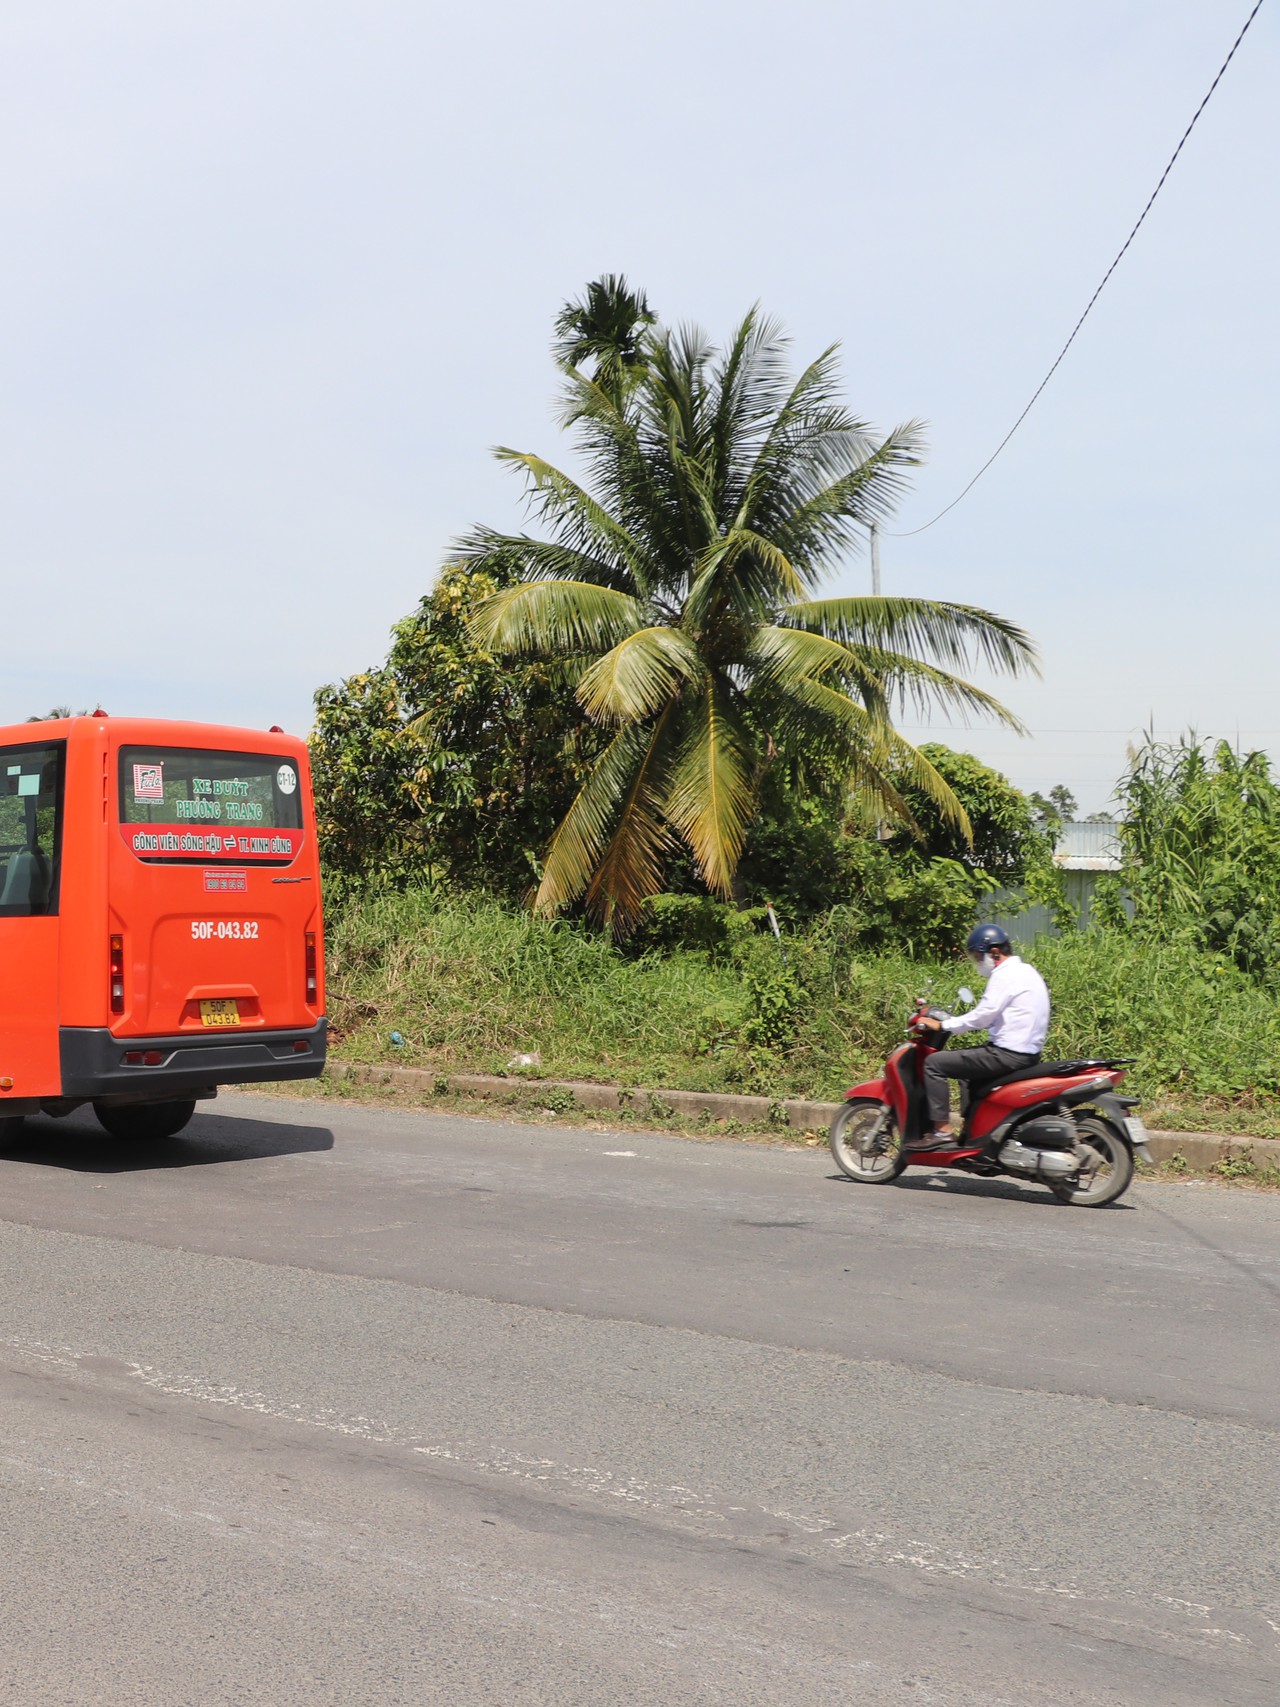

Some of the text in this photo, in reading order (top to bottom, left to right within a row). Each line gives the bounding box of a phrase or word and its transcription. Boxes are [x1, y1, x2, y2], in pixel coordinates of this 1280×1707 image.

[193, 778, 248, 797] XE BUÝT
[278, 772, 296, 787] CT-12
[177, 797, 263, 820] PHƯƠNG TRANG
[133, 832, 157, 851] CÔNG
[159, 832, 181, 851] VIÊN
[181, 833, 203, 851] SÔNG
[205, 833, 221, 855] HẬU
[250, 838, 270, 853] KINH
[191, 921, 259, 939] 50F-043.82
[210, 1001, 226, 1012] 50F
[206, 1013, 236, 1025] 043.82
